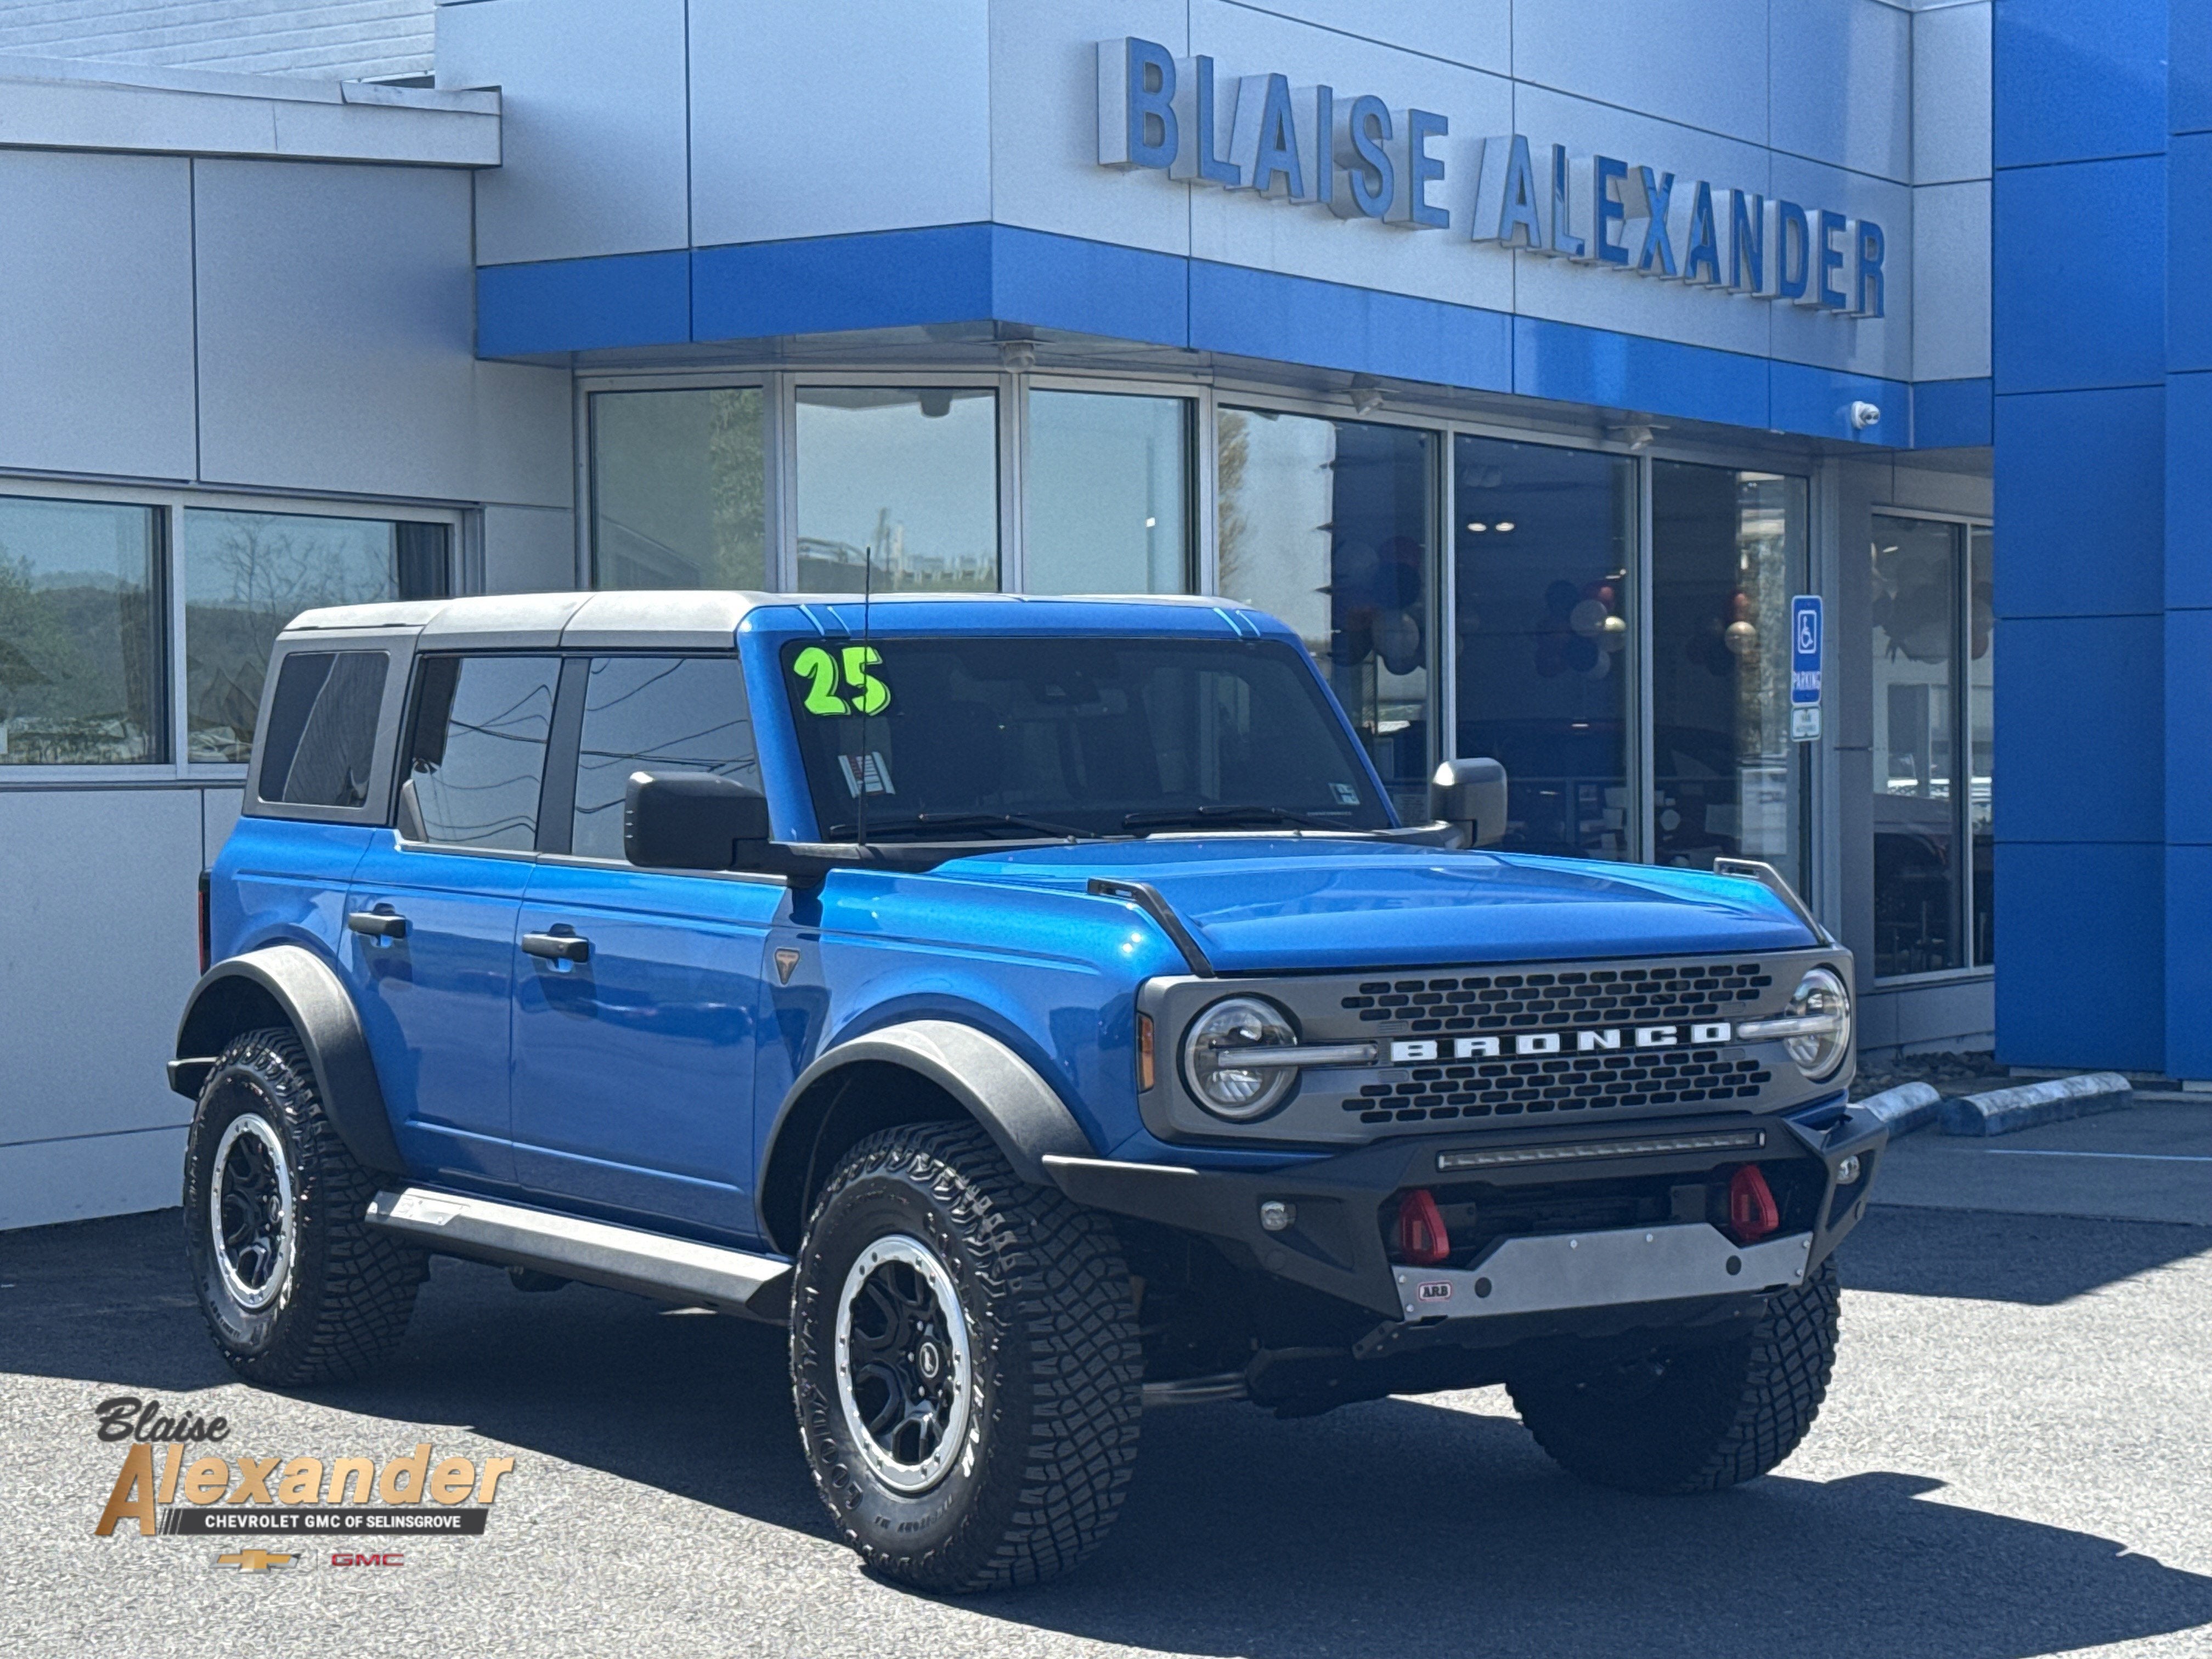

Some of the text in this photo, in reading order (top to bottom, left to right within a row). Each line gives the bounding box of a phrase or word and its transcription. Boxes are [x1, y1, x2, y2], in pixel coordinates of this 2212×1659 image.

[1125, 37, 1886, 319] BLAISE ALEXANDER
[794, 646, 891, 716] 25
[1793, 670, 1820, 690] PARKING
[1391, 1022, 1731, 1062] BRONCO
[1423, 1285, 1448, 1298] ARB
